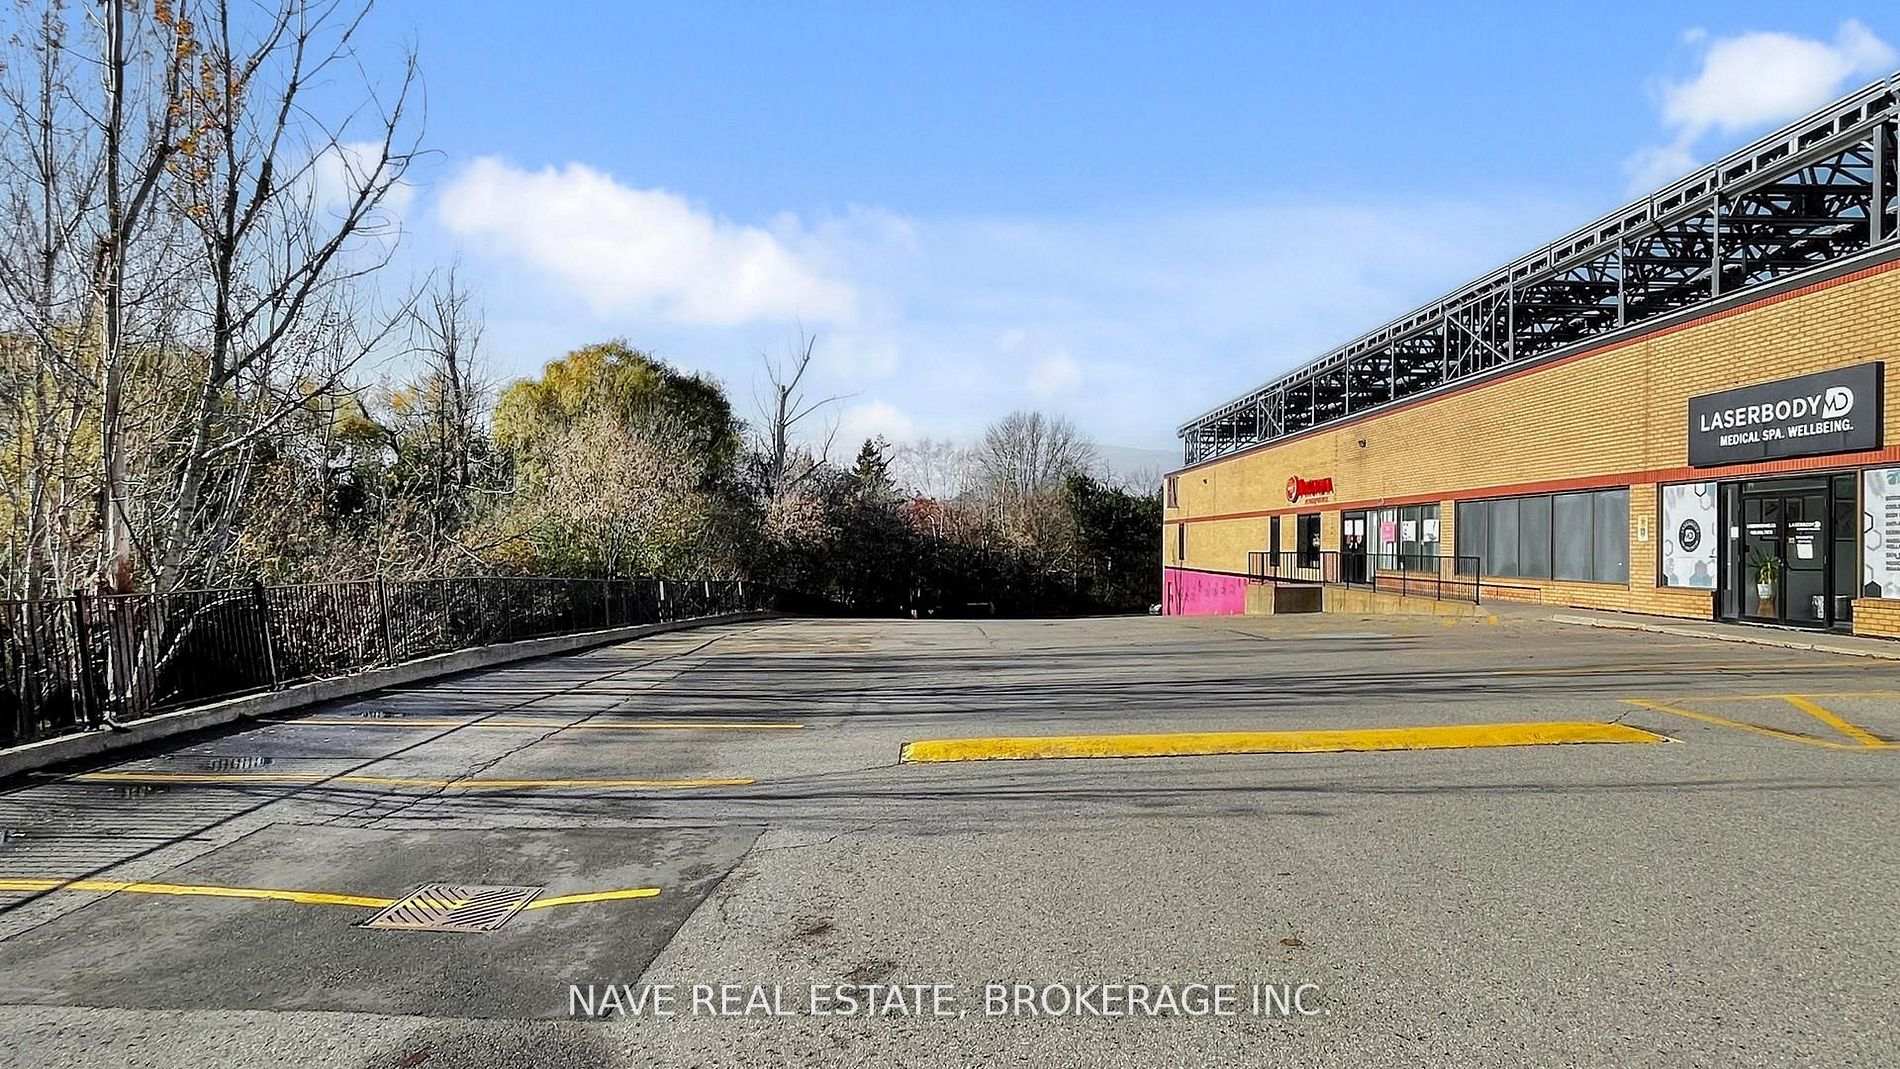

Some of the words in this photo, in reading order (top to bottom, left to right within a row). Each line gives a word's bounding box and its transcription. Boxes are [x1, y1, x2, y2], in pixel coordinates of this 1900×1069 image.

[1720, 431, 1760, 447] MEDICAL
[1761, 427, 1785, 441] SPA.
[1787, 418, 1854, 438] WELLBEING.
